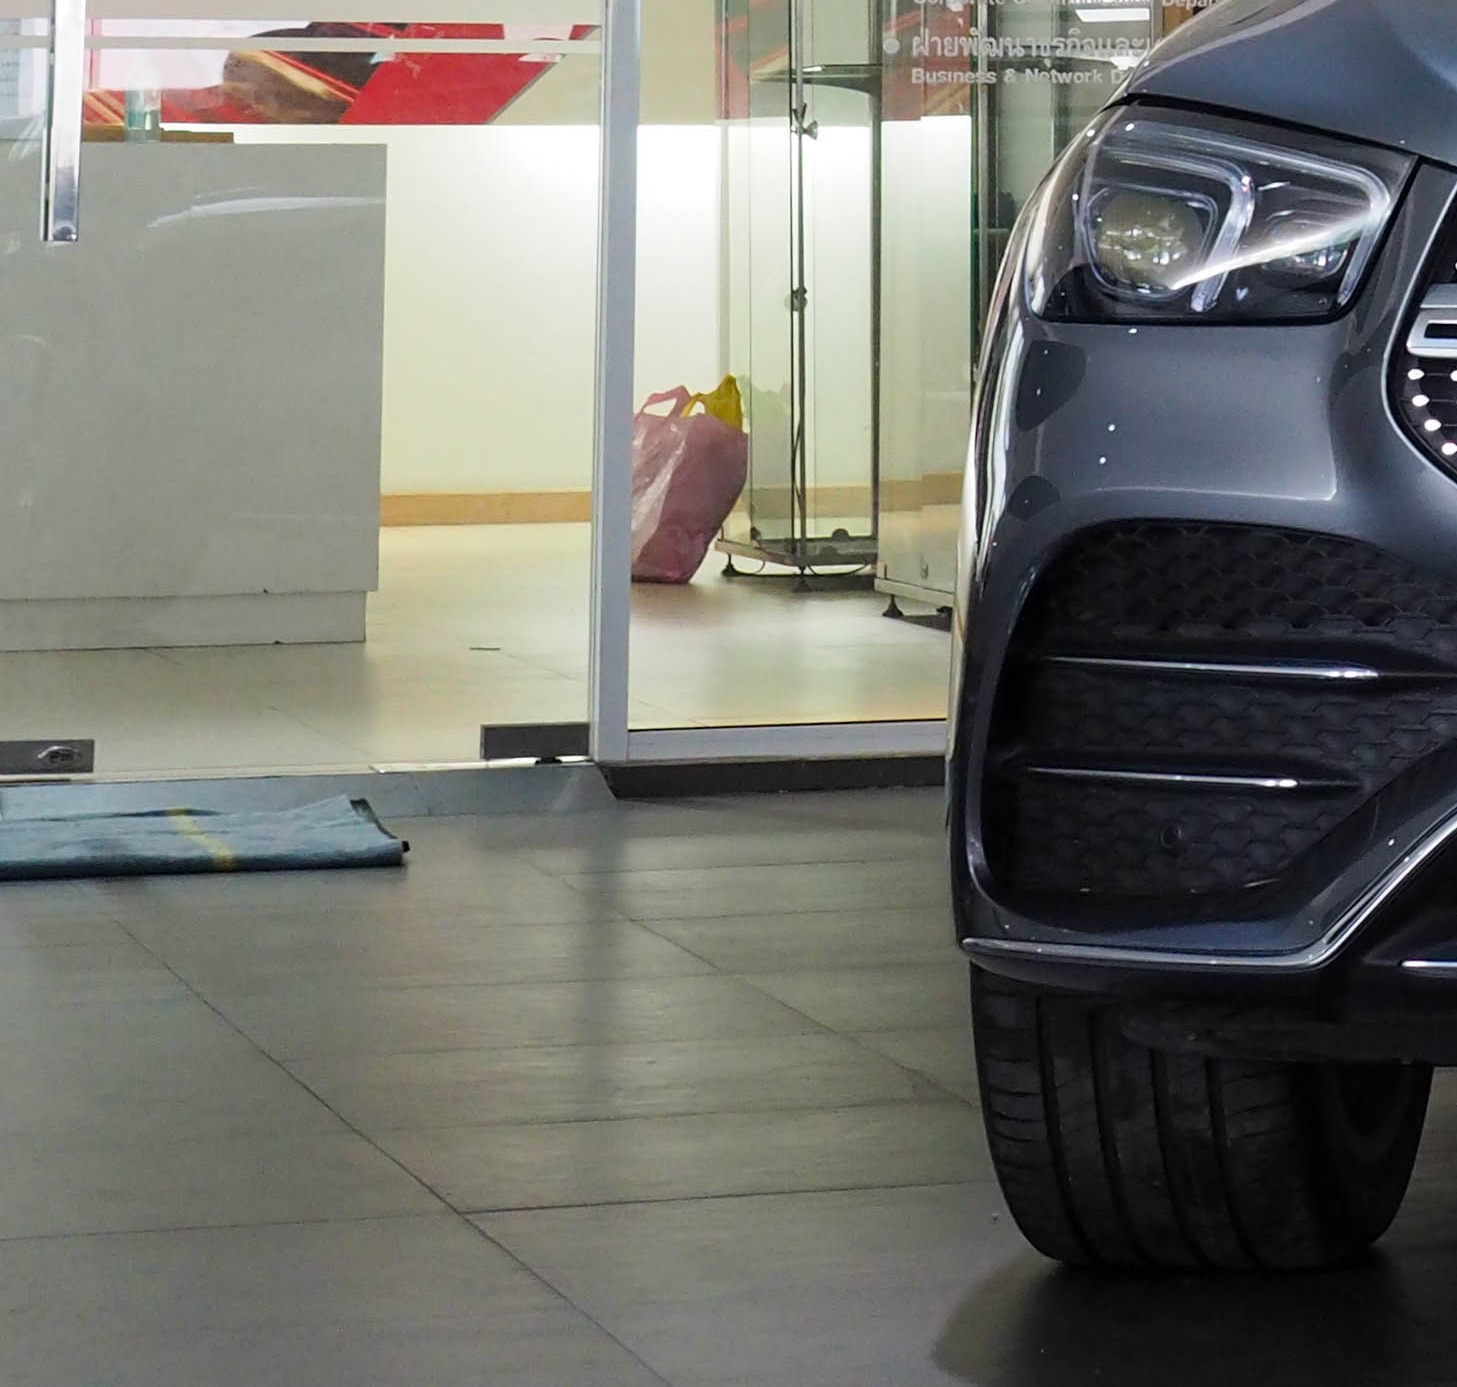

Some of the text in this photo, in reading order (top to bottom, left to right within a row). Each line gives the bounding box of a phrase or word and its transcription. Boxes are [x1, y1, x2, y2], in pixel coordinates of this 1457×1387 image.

[912, 68, 998, 85] Business
[1004, 68, 1016, 85] &
[1025, 68, 1104, 85] Network
